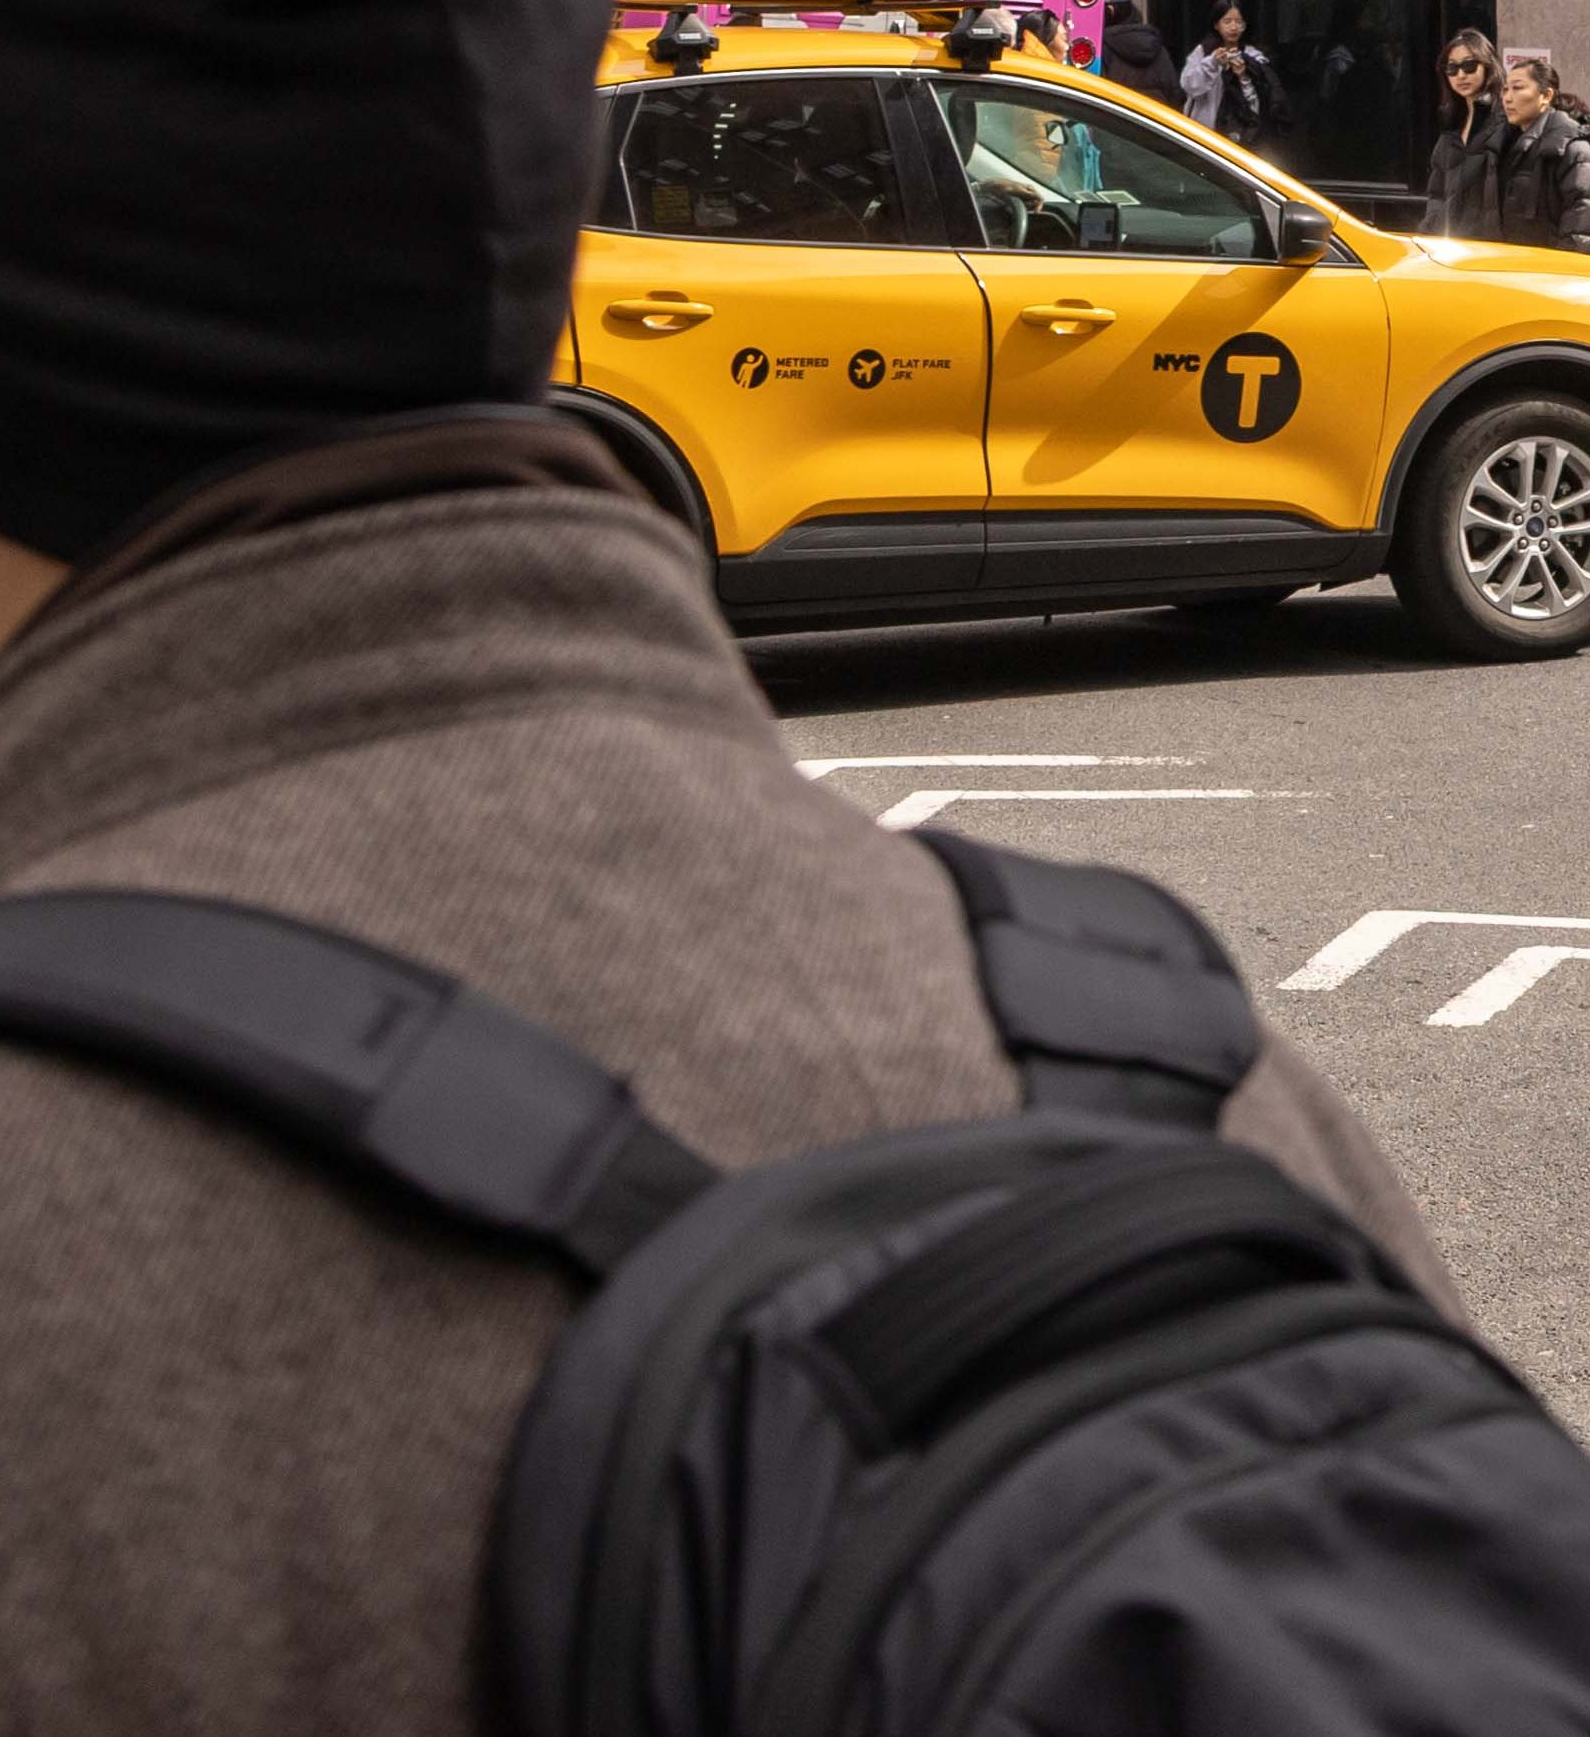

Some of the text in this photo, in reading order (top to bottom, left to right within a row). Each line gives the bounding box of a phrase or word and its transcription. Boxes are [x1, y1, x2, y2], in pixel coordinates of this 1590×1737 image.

[776, 357, 829, 369] METERED
[892, 358, 951, 371] FLAT FARE
[776, 369, 806, 381] FARE
[890, 369, 914, 382] JFK
[1152, 353, 1280, 428] NYC T
